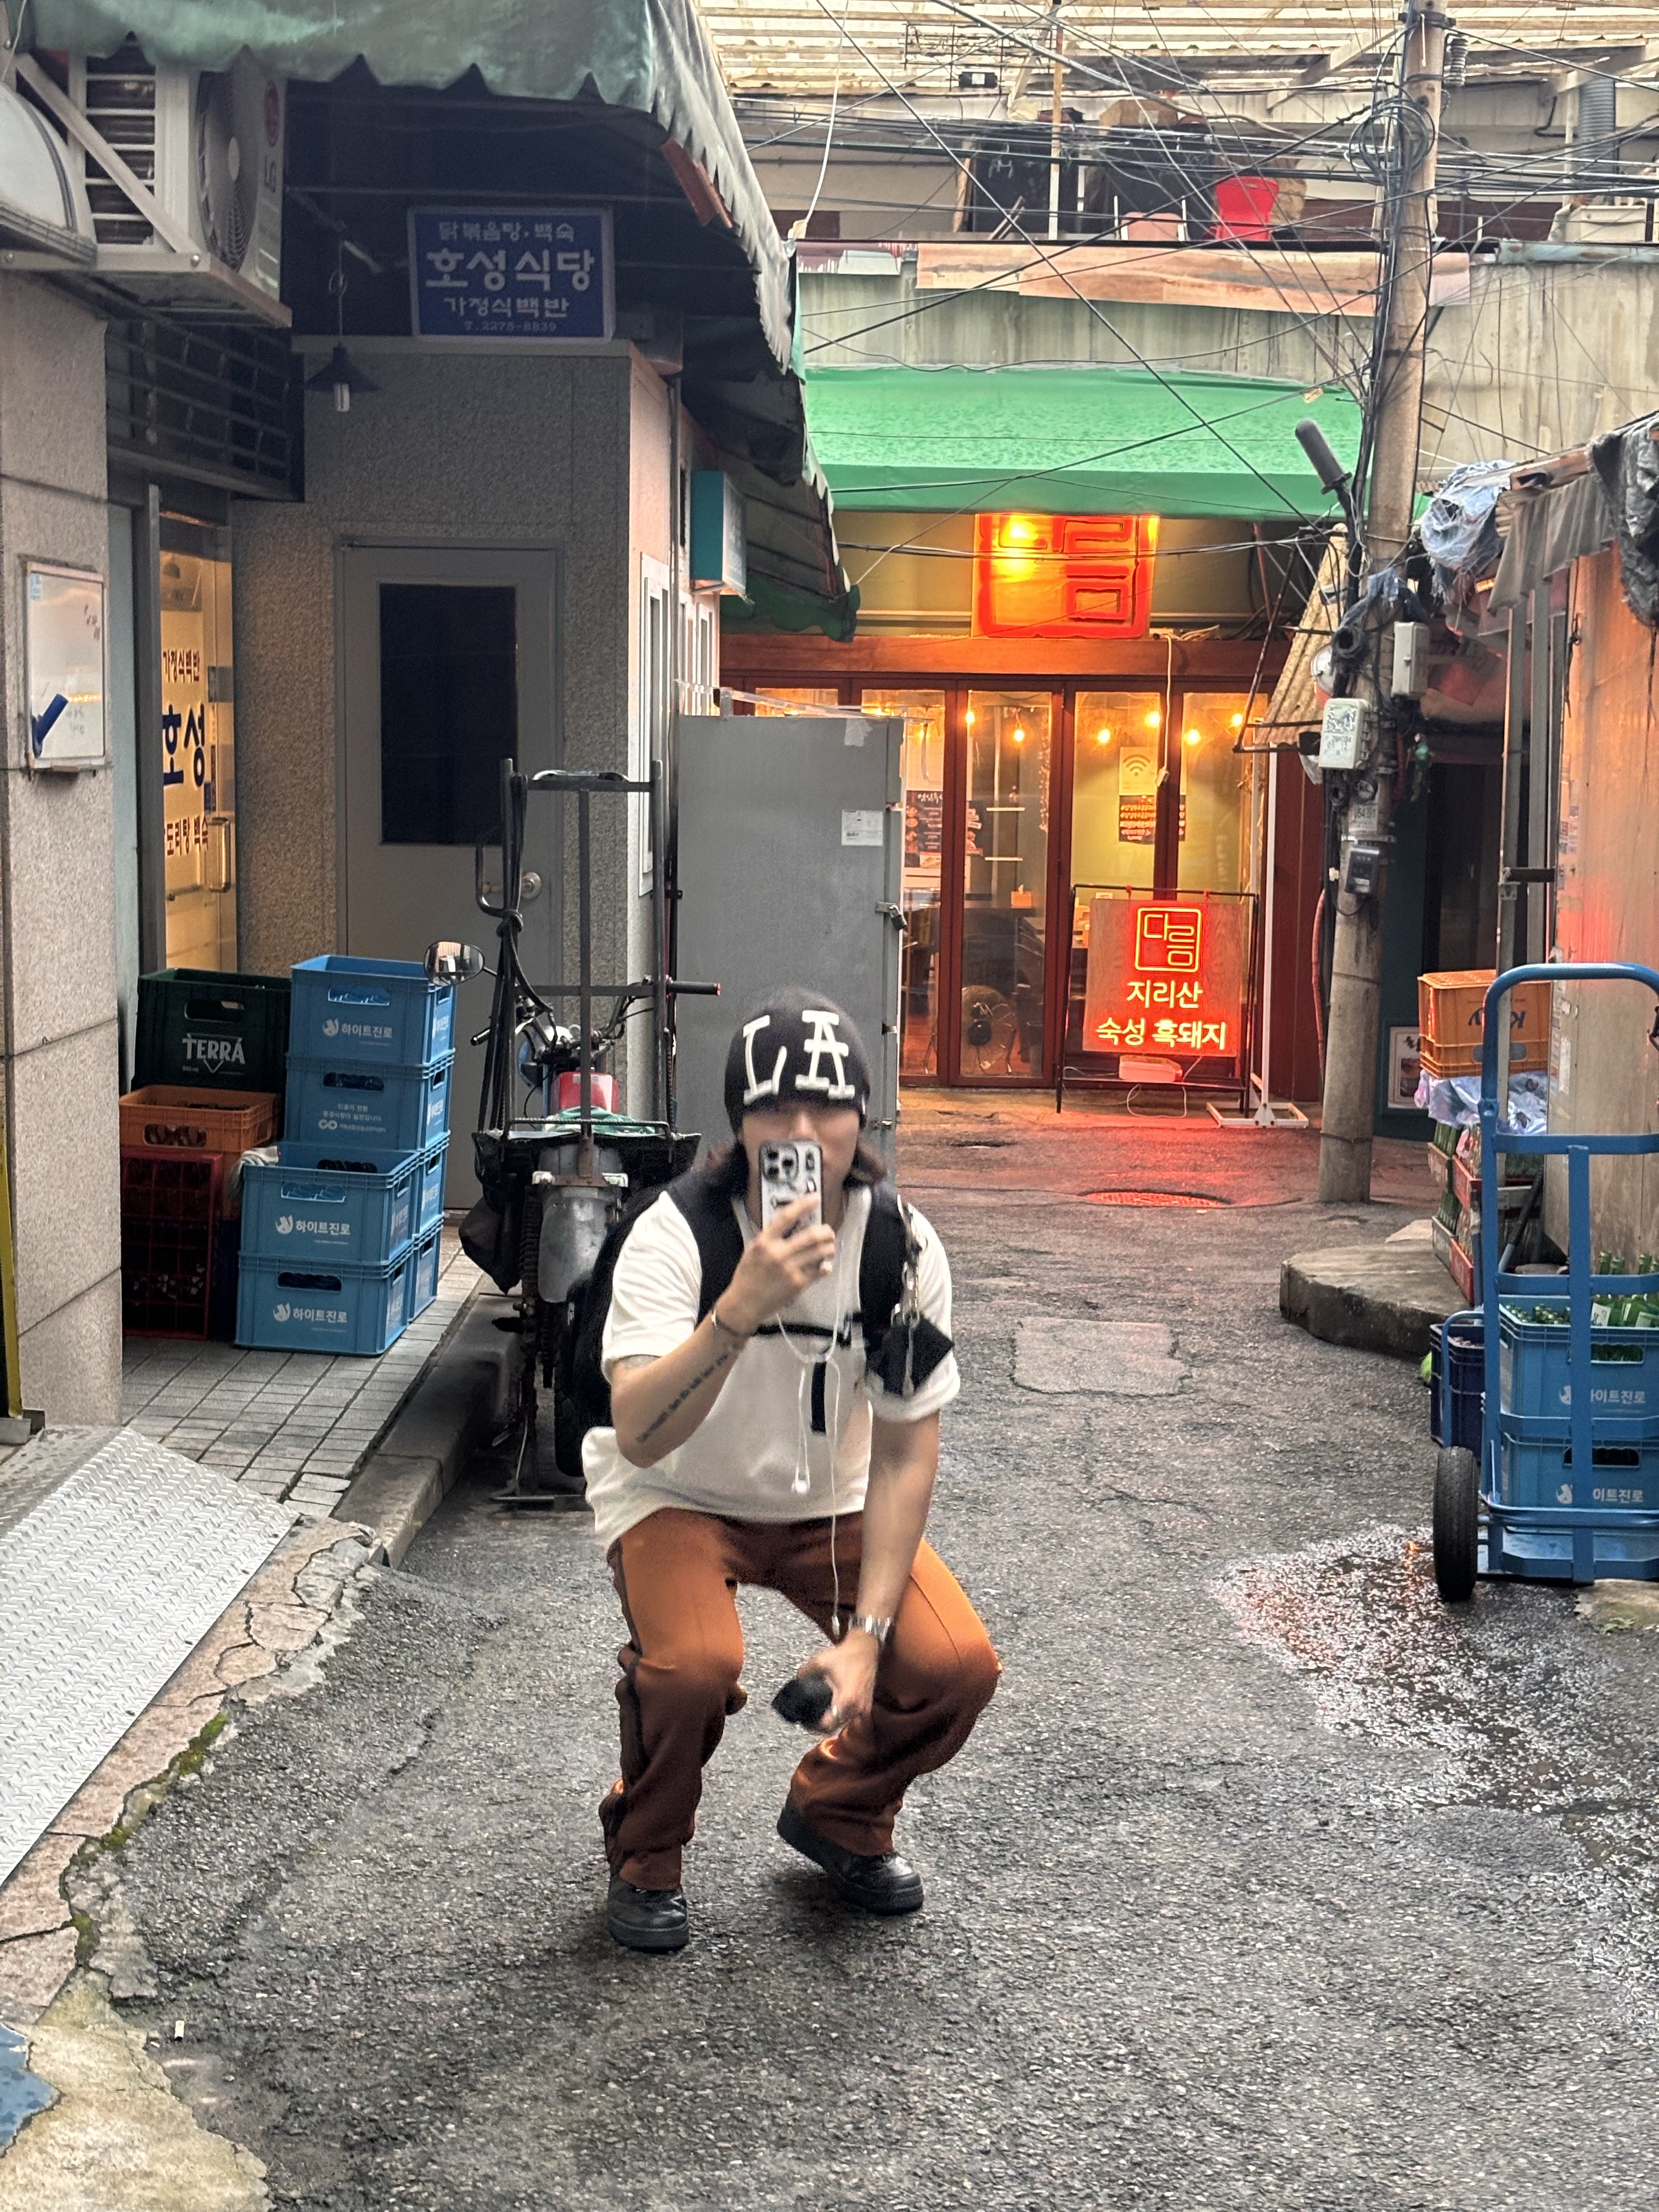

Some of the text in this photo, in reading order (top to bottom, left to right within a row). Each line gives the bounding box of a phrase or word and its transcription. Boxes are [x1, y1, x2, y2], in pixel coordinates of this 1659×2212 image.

[425, 247, 596, 292] 호성식당
[443, 296, 570, 318] 가정식백반
[163, 649, 200, 683] 가정식백반
[162, 703, 205, 788] 호성
[163, 814, 208, 856] 도리탕 백숙
[1142, 912, 1196, 967] 다름
[1126, 979, 1203, 1009] 지리산
[341, 1023, 393, 1039] 하이트진로
[1095, 1017, 1226, 1050] 숙성 흑돼지
[182, 1032, 246, 1065] TERRA
[743, 1009, 855, 1105] LA
[295, 1220, 351, 1235] 하이트진로
[292, 1307, 347, 1323] 하이트진로
[1592, 1487, 1644, 1504] 이트진로
